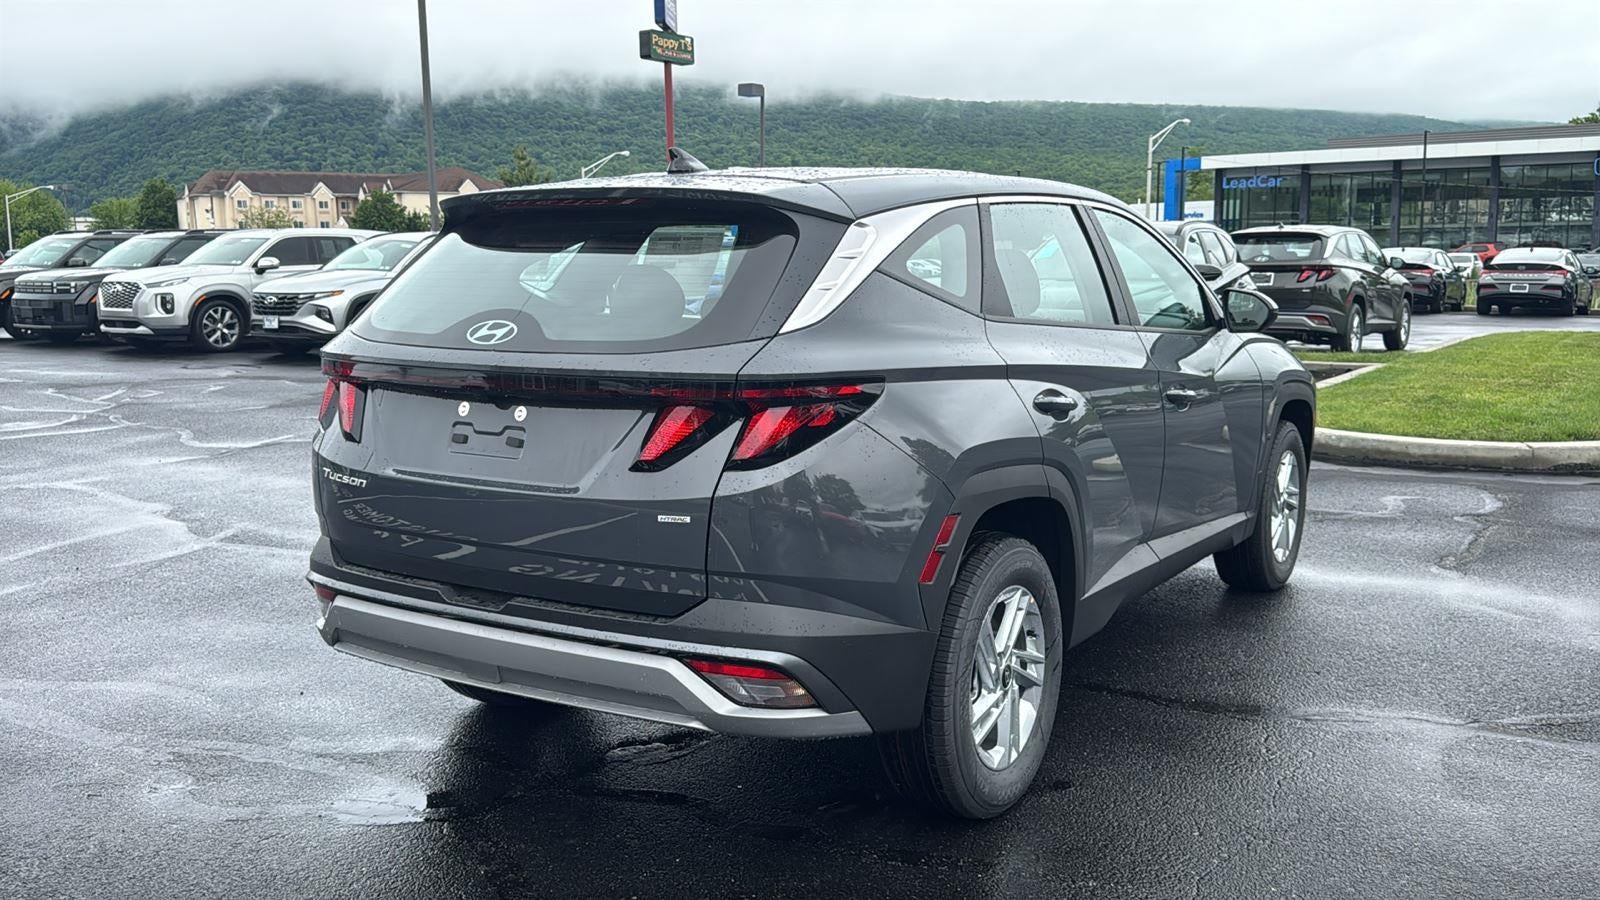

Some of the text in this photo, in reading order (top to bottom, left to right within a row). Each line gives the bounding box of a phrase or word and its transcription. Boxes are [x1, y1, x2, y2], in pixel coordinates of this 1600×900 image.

[652, 34, 679, 50] Pappy
[1222, 175, 1283, 189] LeadCar
[1184, 211, 1204, 219] ervice
[323, 467, 367, 488] Tucson
